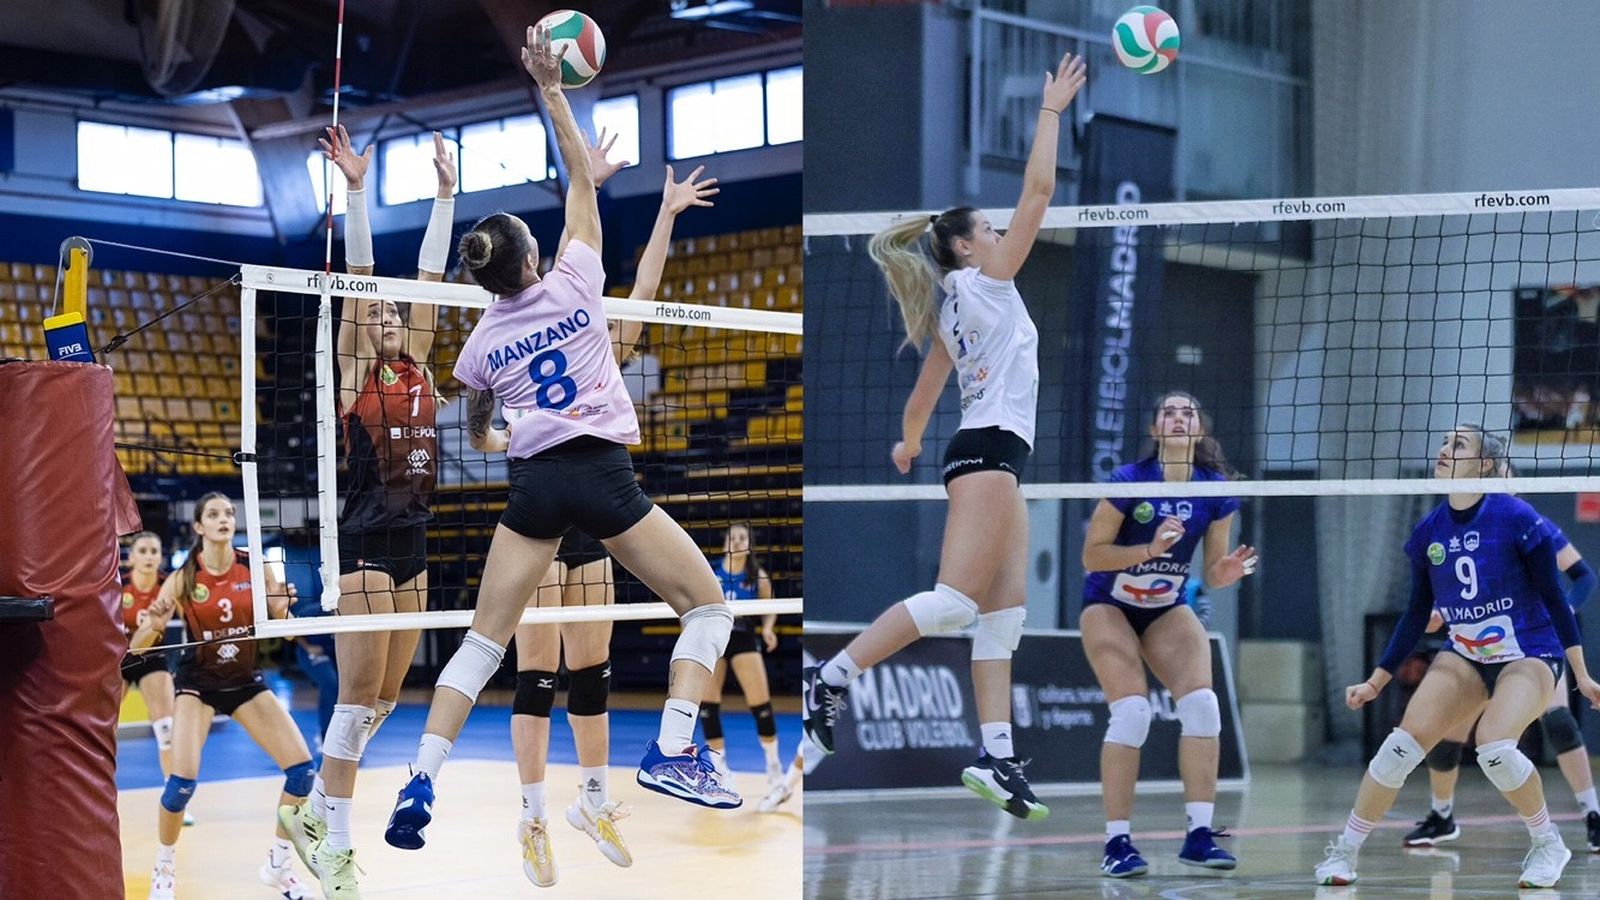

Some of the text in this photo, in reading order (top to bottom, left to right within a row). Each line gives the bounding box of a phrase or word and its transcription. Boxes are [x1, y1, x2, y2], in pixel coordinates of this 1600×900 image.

[1272, 200, 1346, 215] rfevb.com
[1474, 192, 1551, 208] rfevb.com
[1078, 208, 1149, 222] rfevb.com
[307, 273, 378, 293] rfvb.com
[655, 303, 712, 321] rfevb.com
[487, 308, 591, 372] MANZANO
[1092, 180, 1141, 483] OLEIBOLMADRD
[58, 342, 82, 357] FIVB
[528, 348, 578, 411] 8
[1454, 555, 1479, 600] 9
[217, 597, 234, 623] 3
[1454, 597, 1514, 620] MADRID
[851, 664, 964, 721] MADRID
